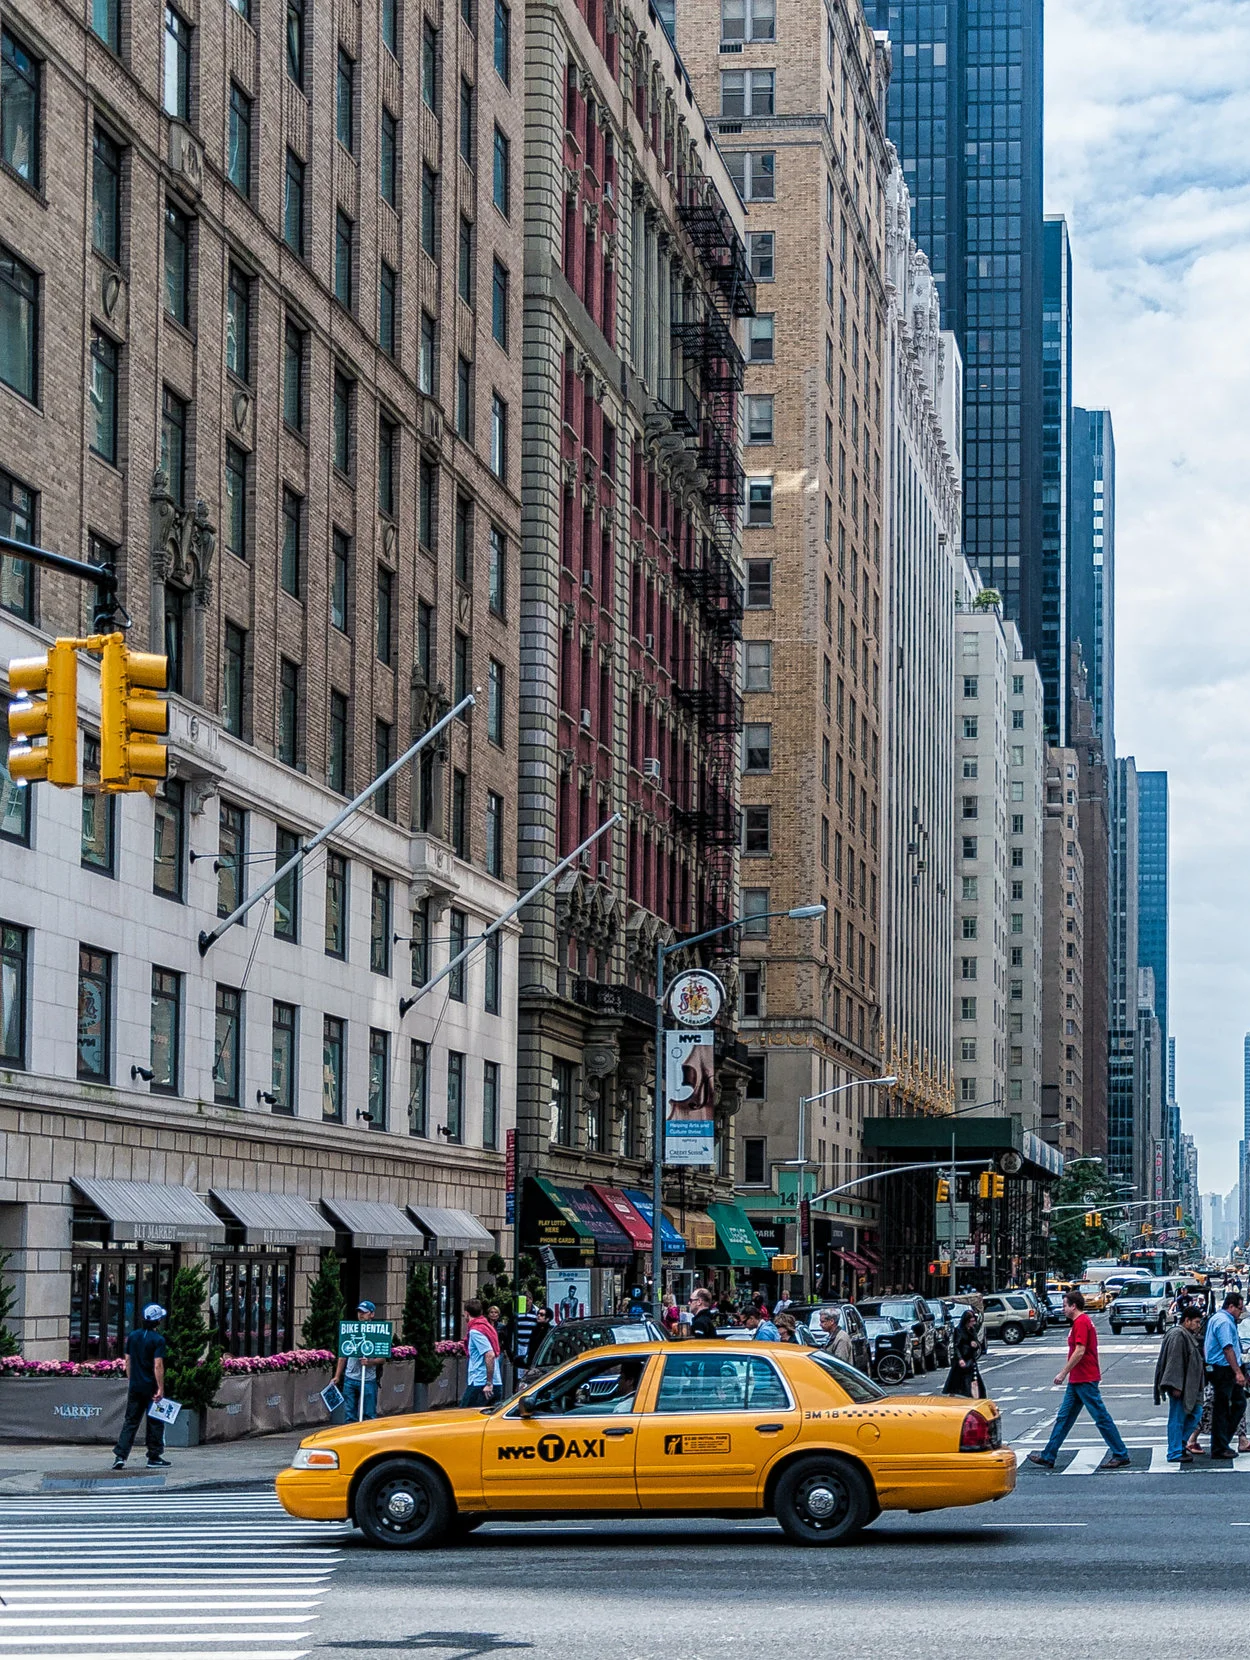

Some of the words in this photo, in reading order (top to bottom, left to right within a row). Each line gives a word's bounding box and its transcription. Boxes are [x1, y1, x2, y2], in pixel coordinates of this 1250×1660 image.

[680, 1015, 711, 1024] BARBADOS
[679, 1034, 702, 1043] NYC
[538, 1219, 551, 1227] PLAY
[133, 1224, 147, 1239] BLT
[148, 1225, 178, 1240] MARKET
[754, 1230, 775, 1238] PARK
[341, 1323, 359, 1335] BIKE
[361, 1323, 390, 1335] RENTAL
[53, 1405, 102, 1417] MARKET
[825, 1410, 840, 1419] 18
[498, 1446, 536, 1460] NYC
[541, 1438, 606, 1460] TAXI
